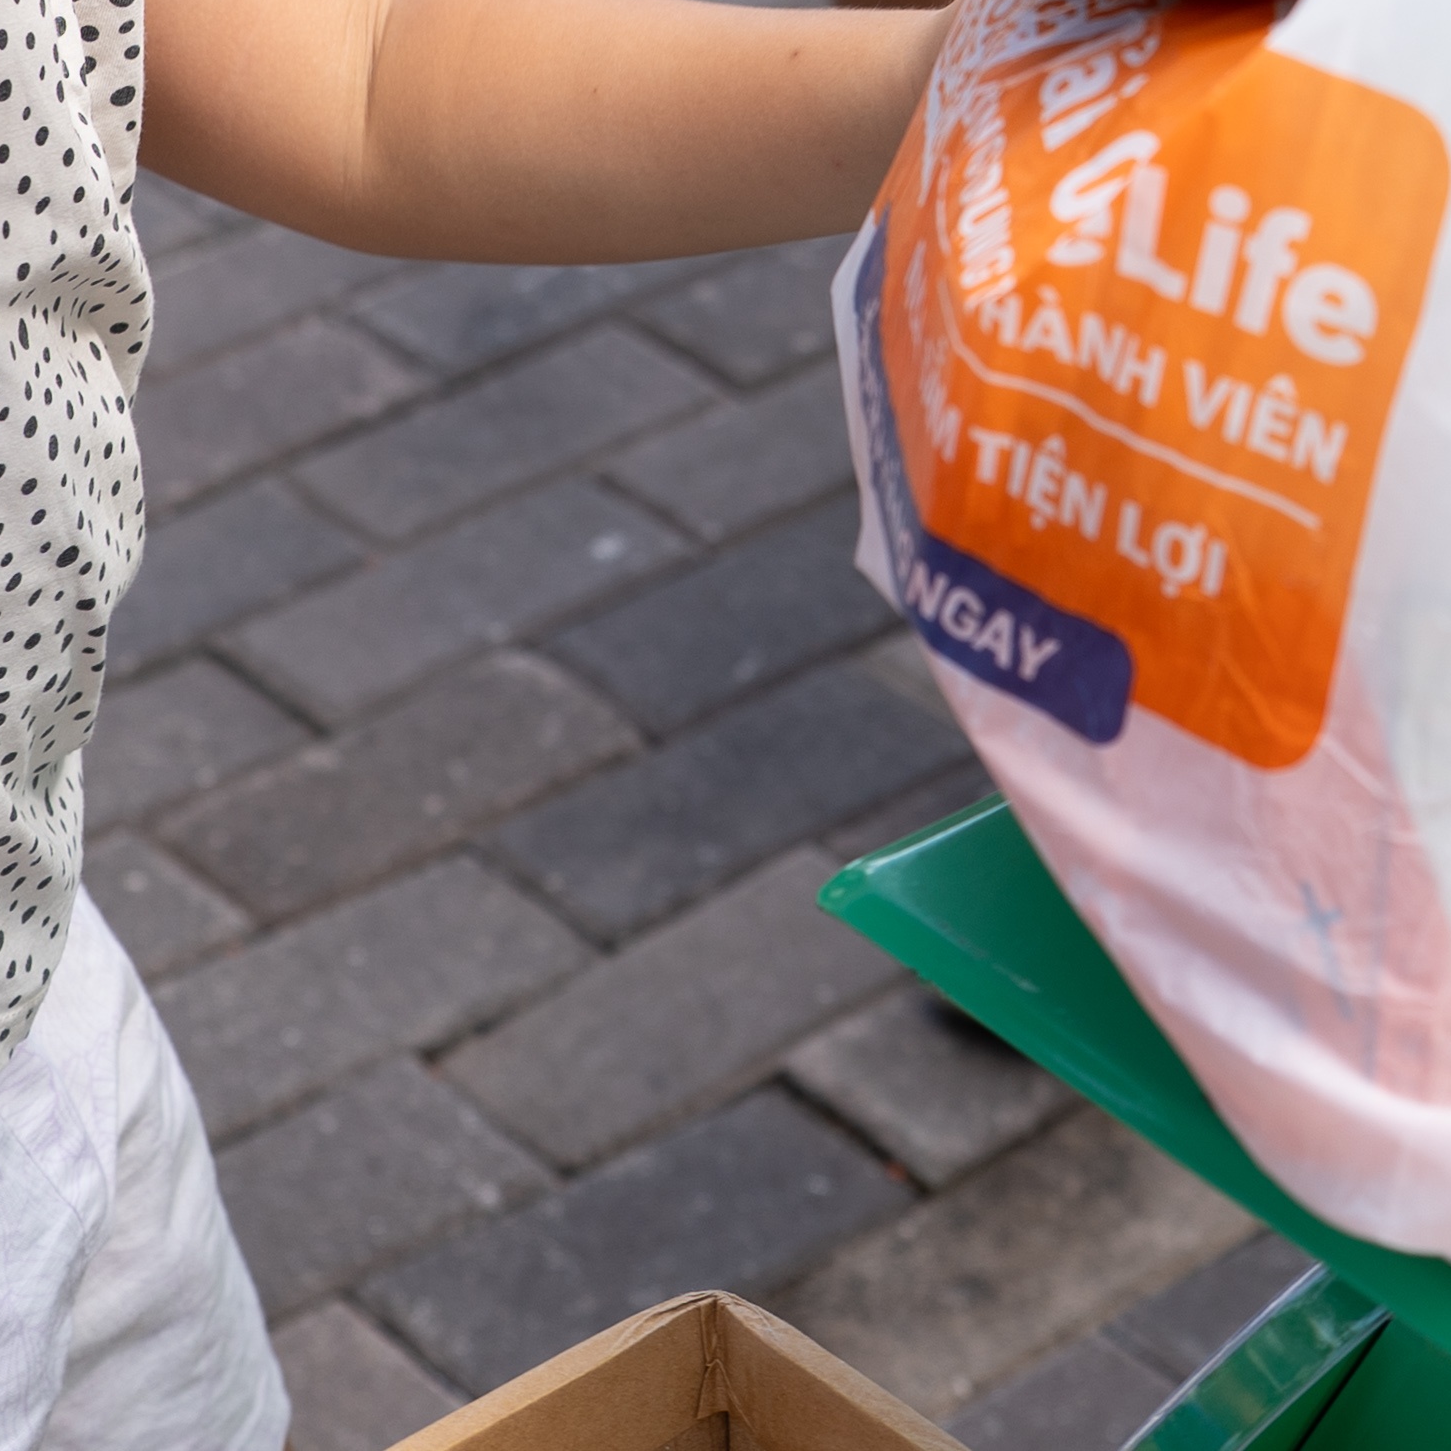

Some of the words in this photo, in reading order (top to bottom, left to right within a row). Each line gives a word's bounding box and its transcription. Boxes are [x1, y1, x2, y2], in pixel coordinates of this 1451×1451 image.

[1183, 359, 1347, 483] VIÊN
[968, 426, 1107, 546] TIỆN
[1116, 499, 1228, 601] LỢI
[903, 562, 1061, 682] NGAY
